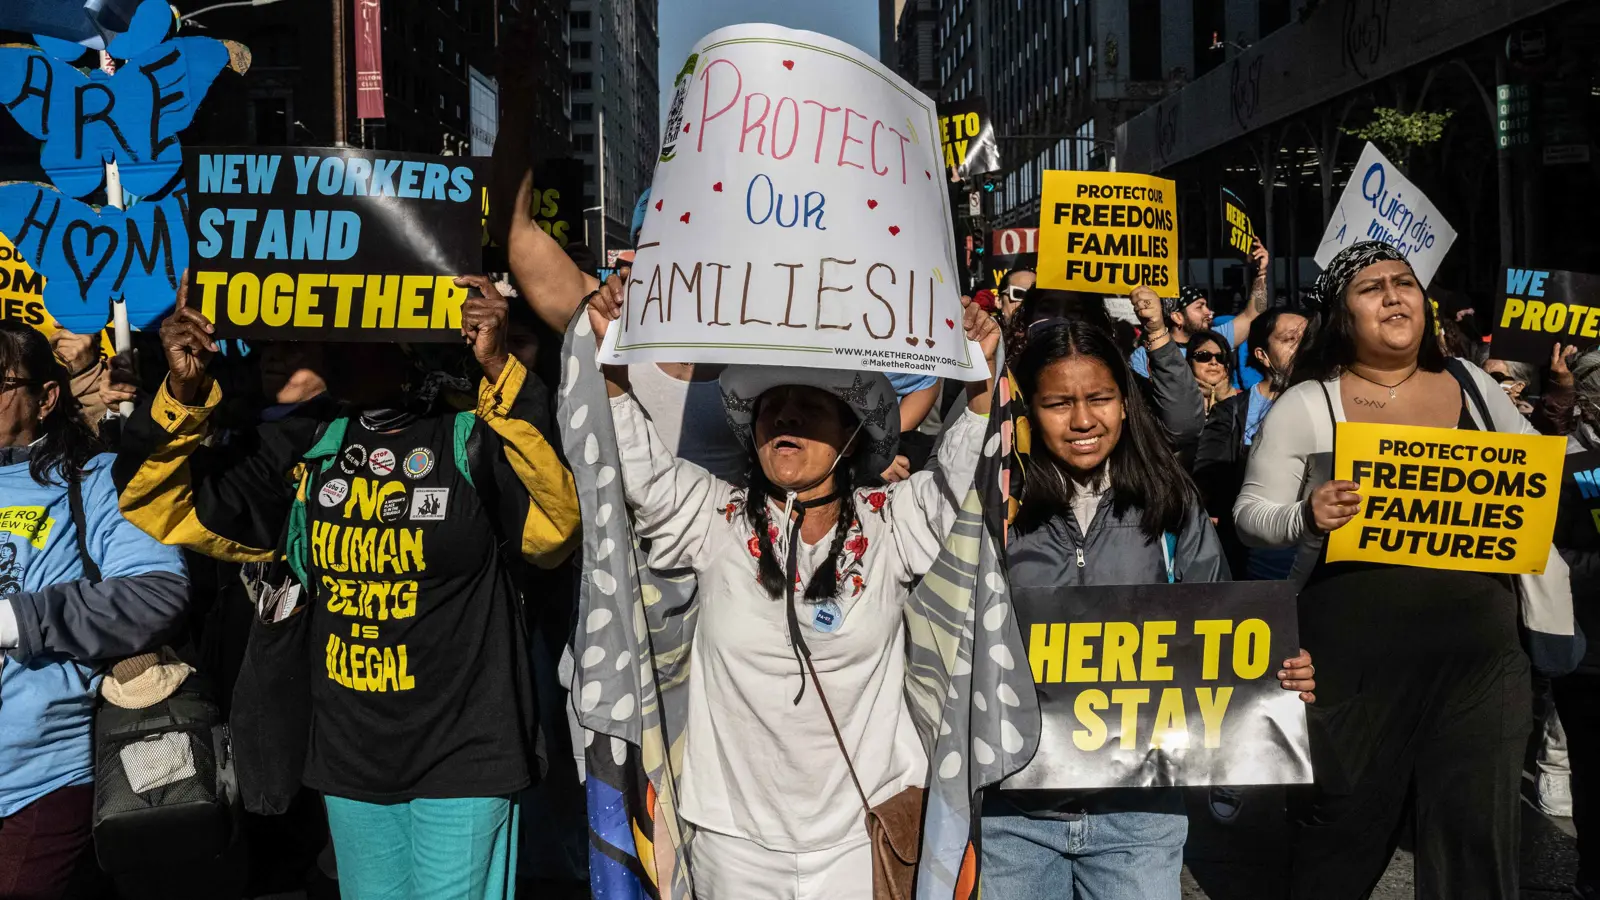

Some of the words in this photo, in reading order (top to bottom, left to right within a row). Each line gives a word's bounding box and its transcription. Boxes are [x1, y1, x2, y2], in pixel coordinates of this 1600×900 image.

[9, 50, 184, 162] ARE
[697, 58, 911, 185] PROTECT
[952, 111, 980, 140] TO
[942, 139, 969, 169] AY
[199, 155, 282, 194] NEW
[294, 156, 474, 202] YORKERS
[1076, 184, 1147, 200] PROTECT
[1147, 188, 1164, 204] OUR
[746, 173, 827, 231] OUR
[1054, 202, 1173, 231] FREEDOMS
[1226, 202, 1246, 232] HERE
[197, 208, 361, 261] STAND
[1067, 232, 1169, 259] FAMILIES
[1230, 226, 1253, 255] STAY
[1066, 260, 1169, 287] FUTURES
[1506, 268, 1550, 297] WE
[196, 271, 468, 329] TOGETHER
[1500, 298, 1600, 339] PROTE
[834, 347, 957, 366] WWW.MAKETHEROADNY.ORG
[861, 358, 936, 372] @MaketheRoadNY
[1379, 439, 1479, 462] PROTECT
[1481, 447, 1527, 465] OUR
[1352, 460, 1547, 499] FREEDOMS
[1364, 495, 1525, 530] FAMILIES
[312, 521, 426, 573] HUMAN
[1358, 526, 1518, 561] FUTURES
[322, 576, 418, 621] BEING
[351, 623, 379, 639] IS
[326, 633, 416, 693] ILLEGAL
[1029, 620, 1177, 684] HERE
[1194, 618, 1272, 681] TO
[1072, 687, 1234, 752] STAY
